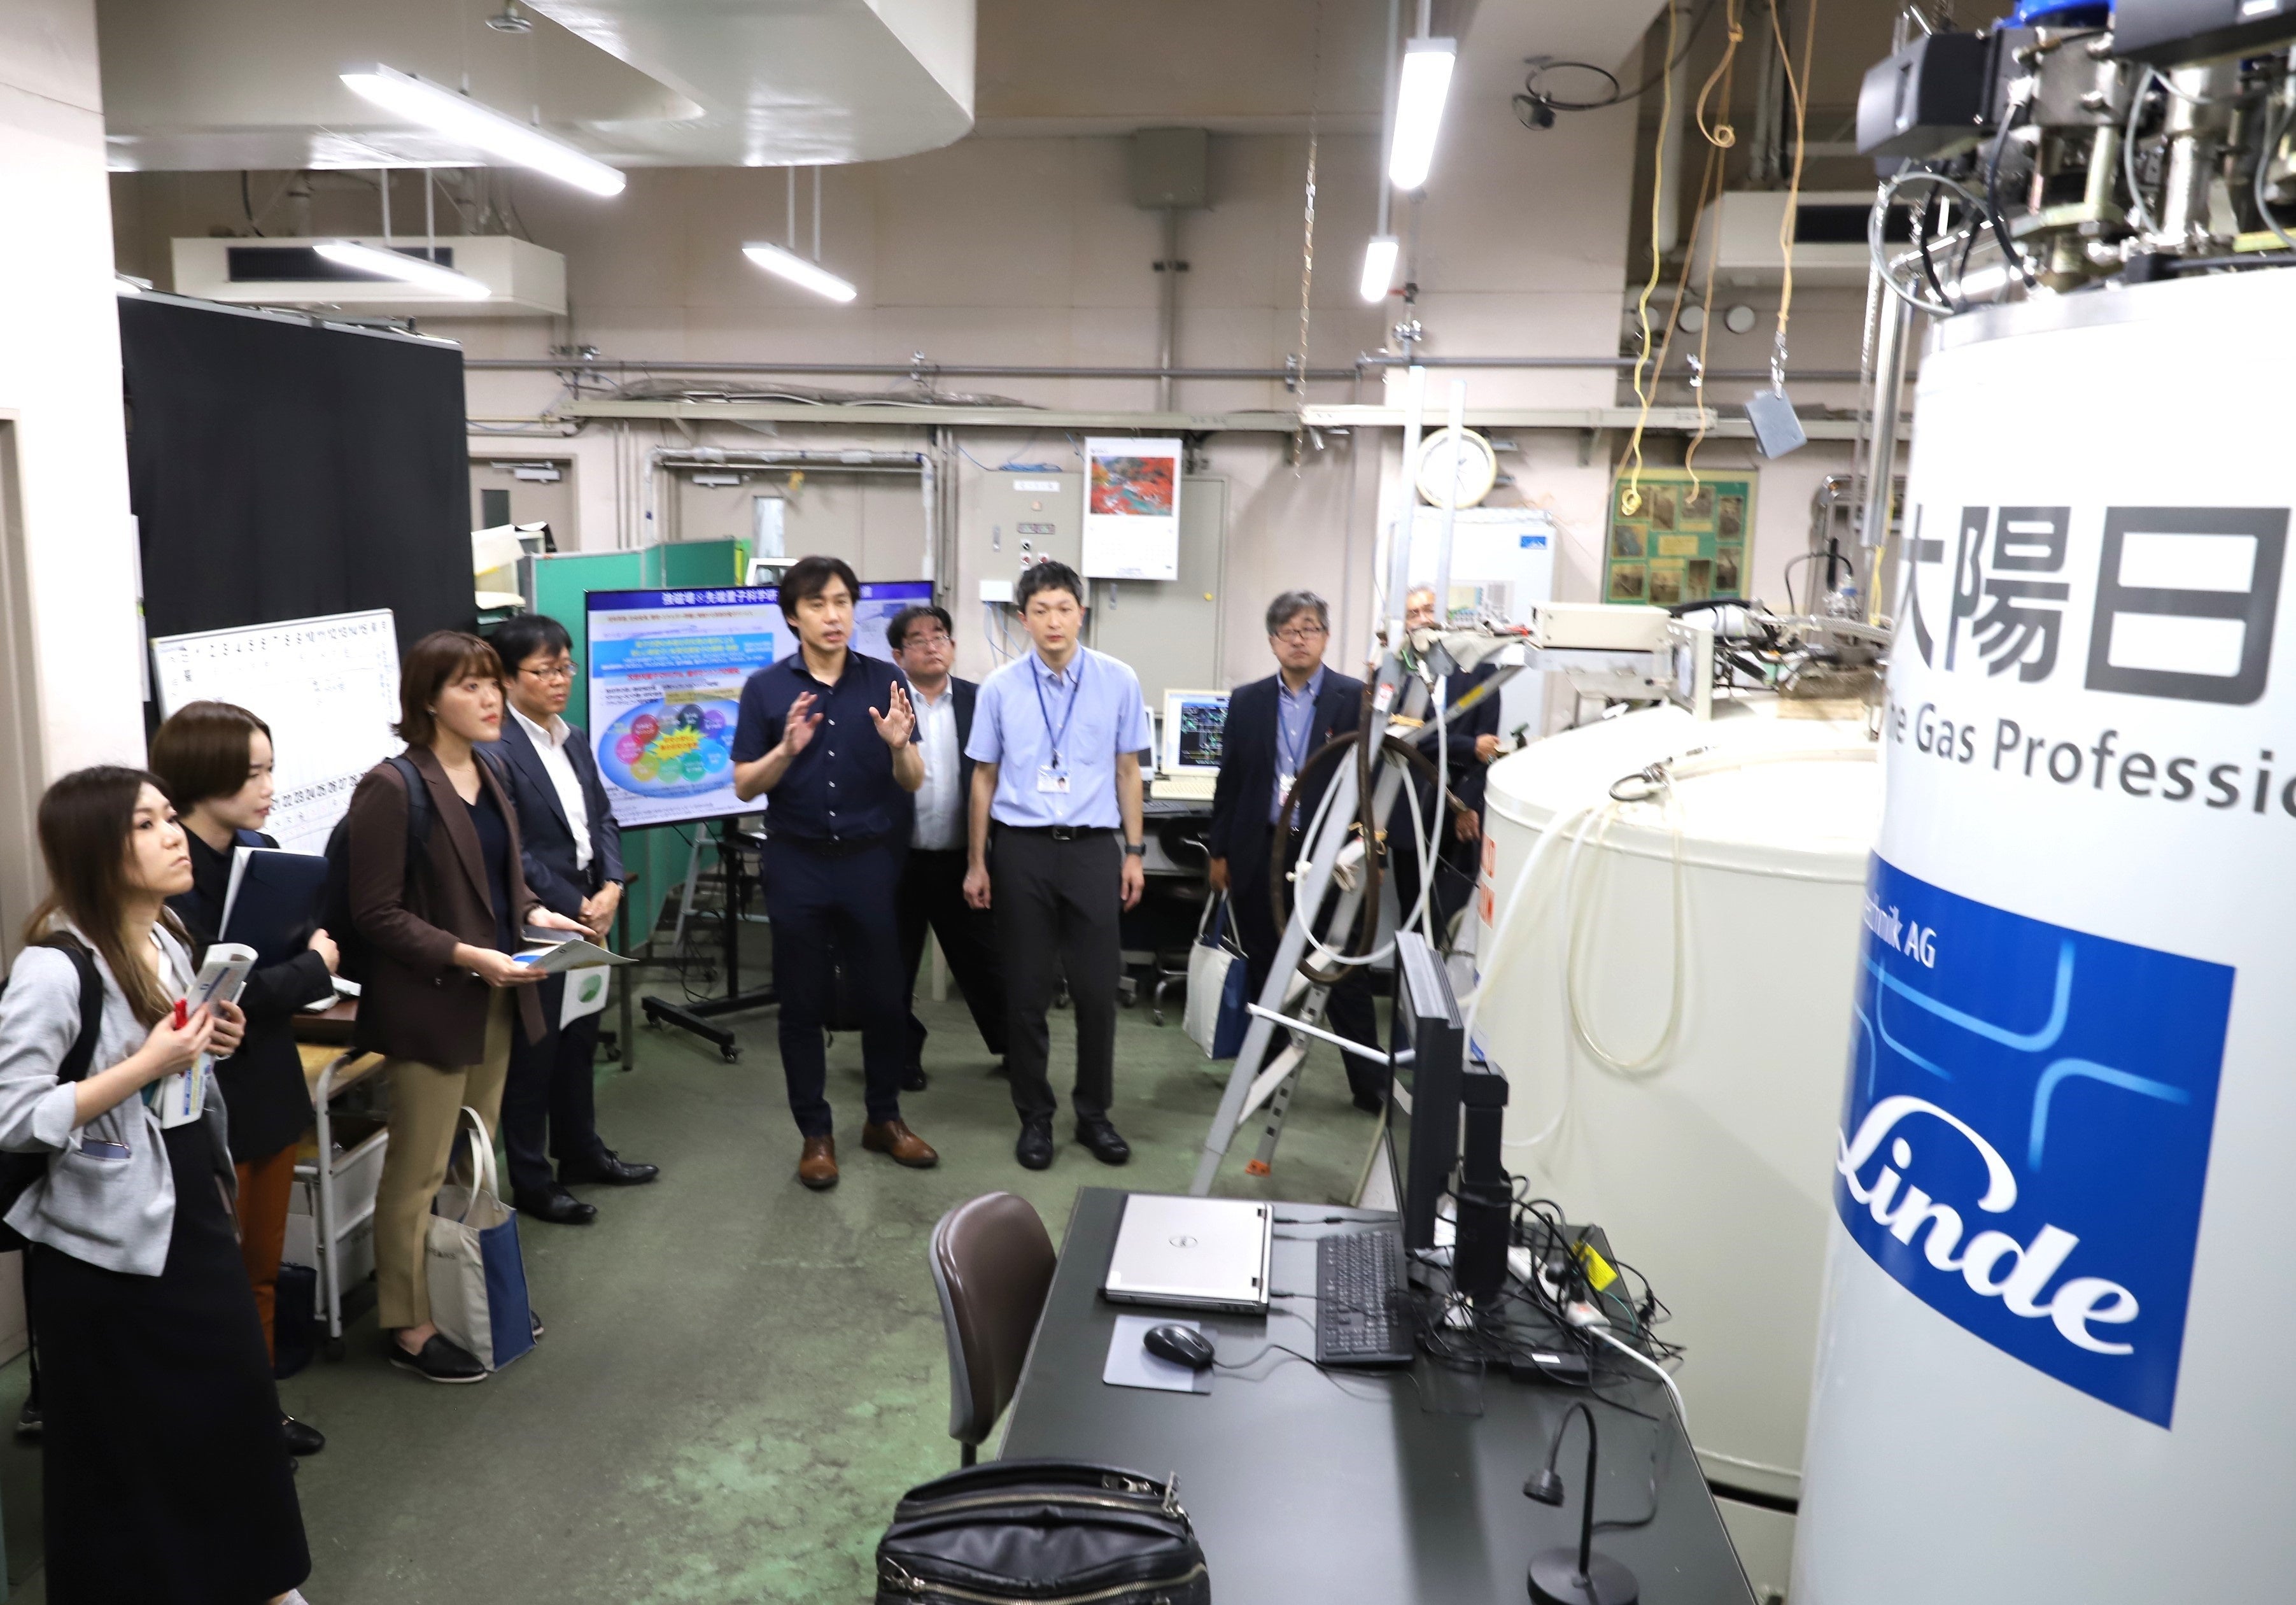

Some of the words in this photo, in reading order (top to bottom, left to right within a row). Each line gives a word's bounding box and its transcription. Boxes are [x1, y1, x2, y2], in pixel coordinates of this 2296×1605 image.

[1915, 703, 1976, 763] Gas
[1903, 920, 1938, 969] AG
[1837, 1094, 2139, 1355] Linde
